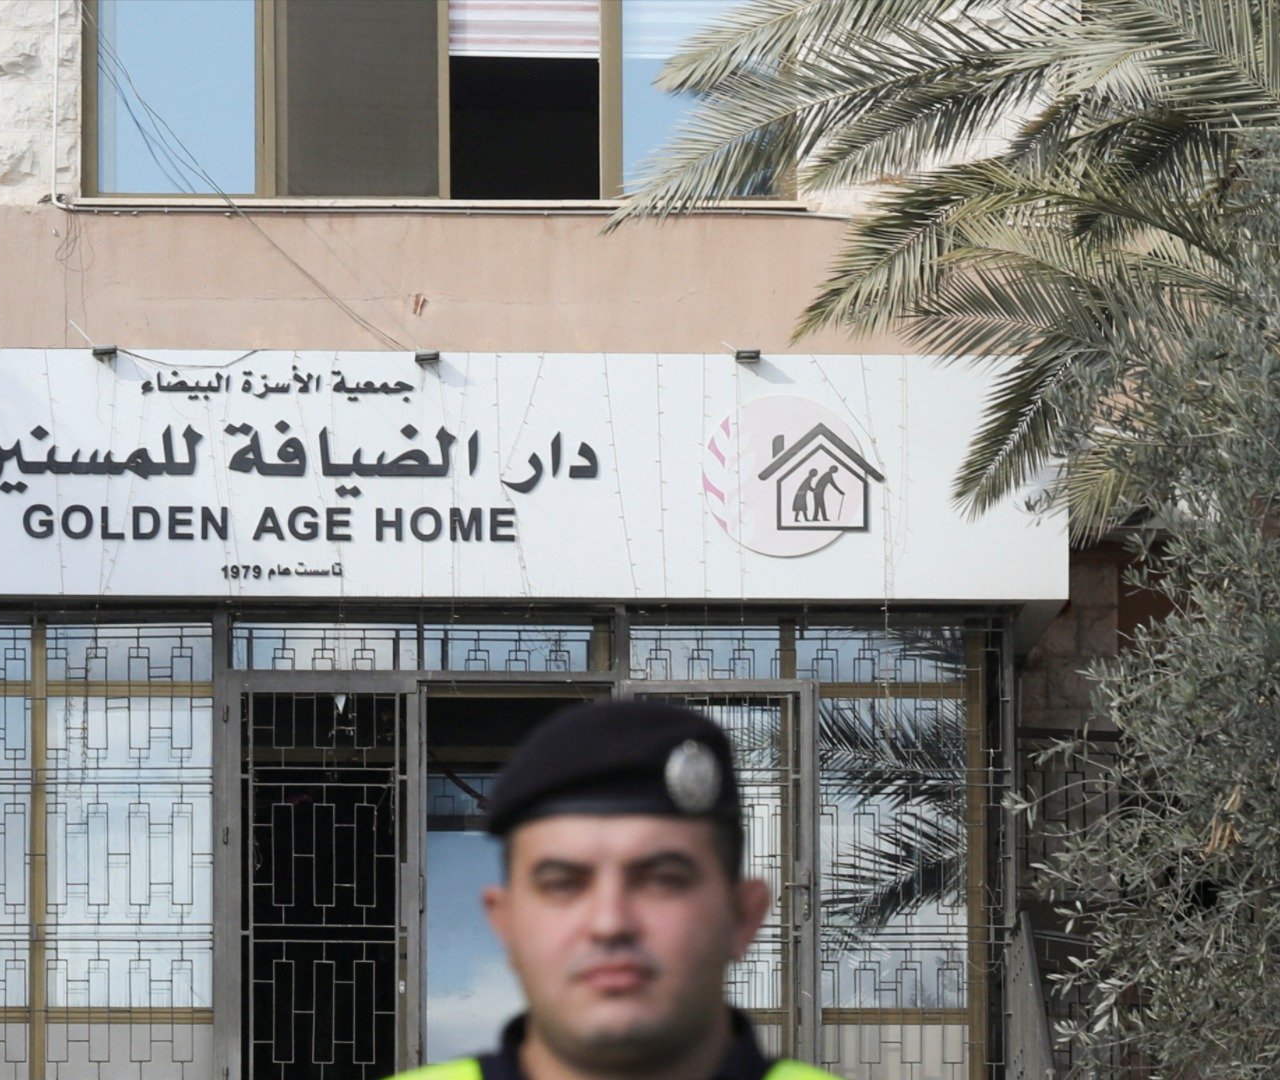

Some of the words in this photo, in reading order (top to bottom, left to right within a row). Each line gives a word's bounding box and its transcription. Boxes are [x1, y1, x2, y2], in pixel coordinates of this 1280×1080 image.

[140, 370, 231, 401] البيضاء
[331, 370, 414, 403] جمعية
[223, 420, 479, 498] الضيافة
[501, 430, 598, 494] دار
[22, 503, 228, 541] GOLDEN
[252, 506, 352, 542] AGE
[375, 506, 516, 542] HOME
[221, 564, 263, 580] 1979
[267, 564, 292, 580] عام
